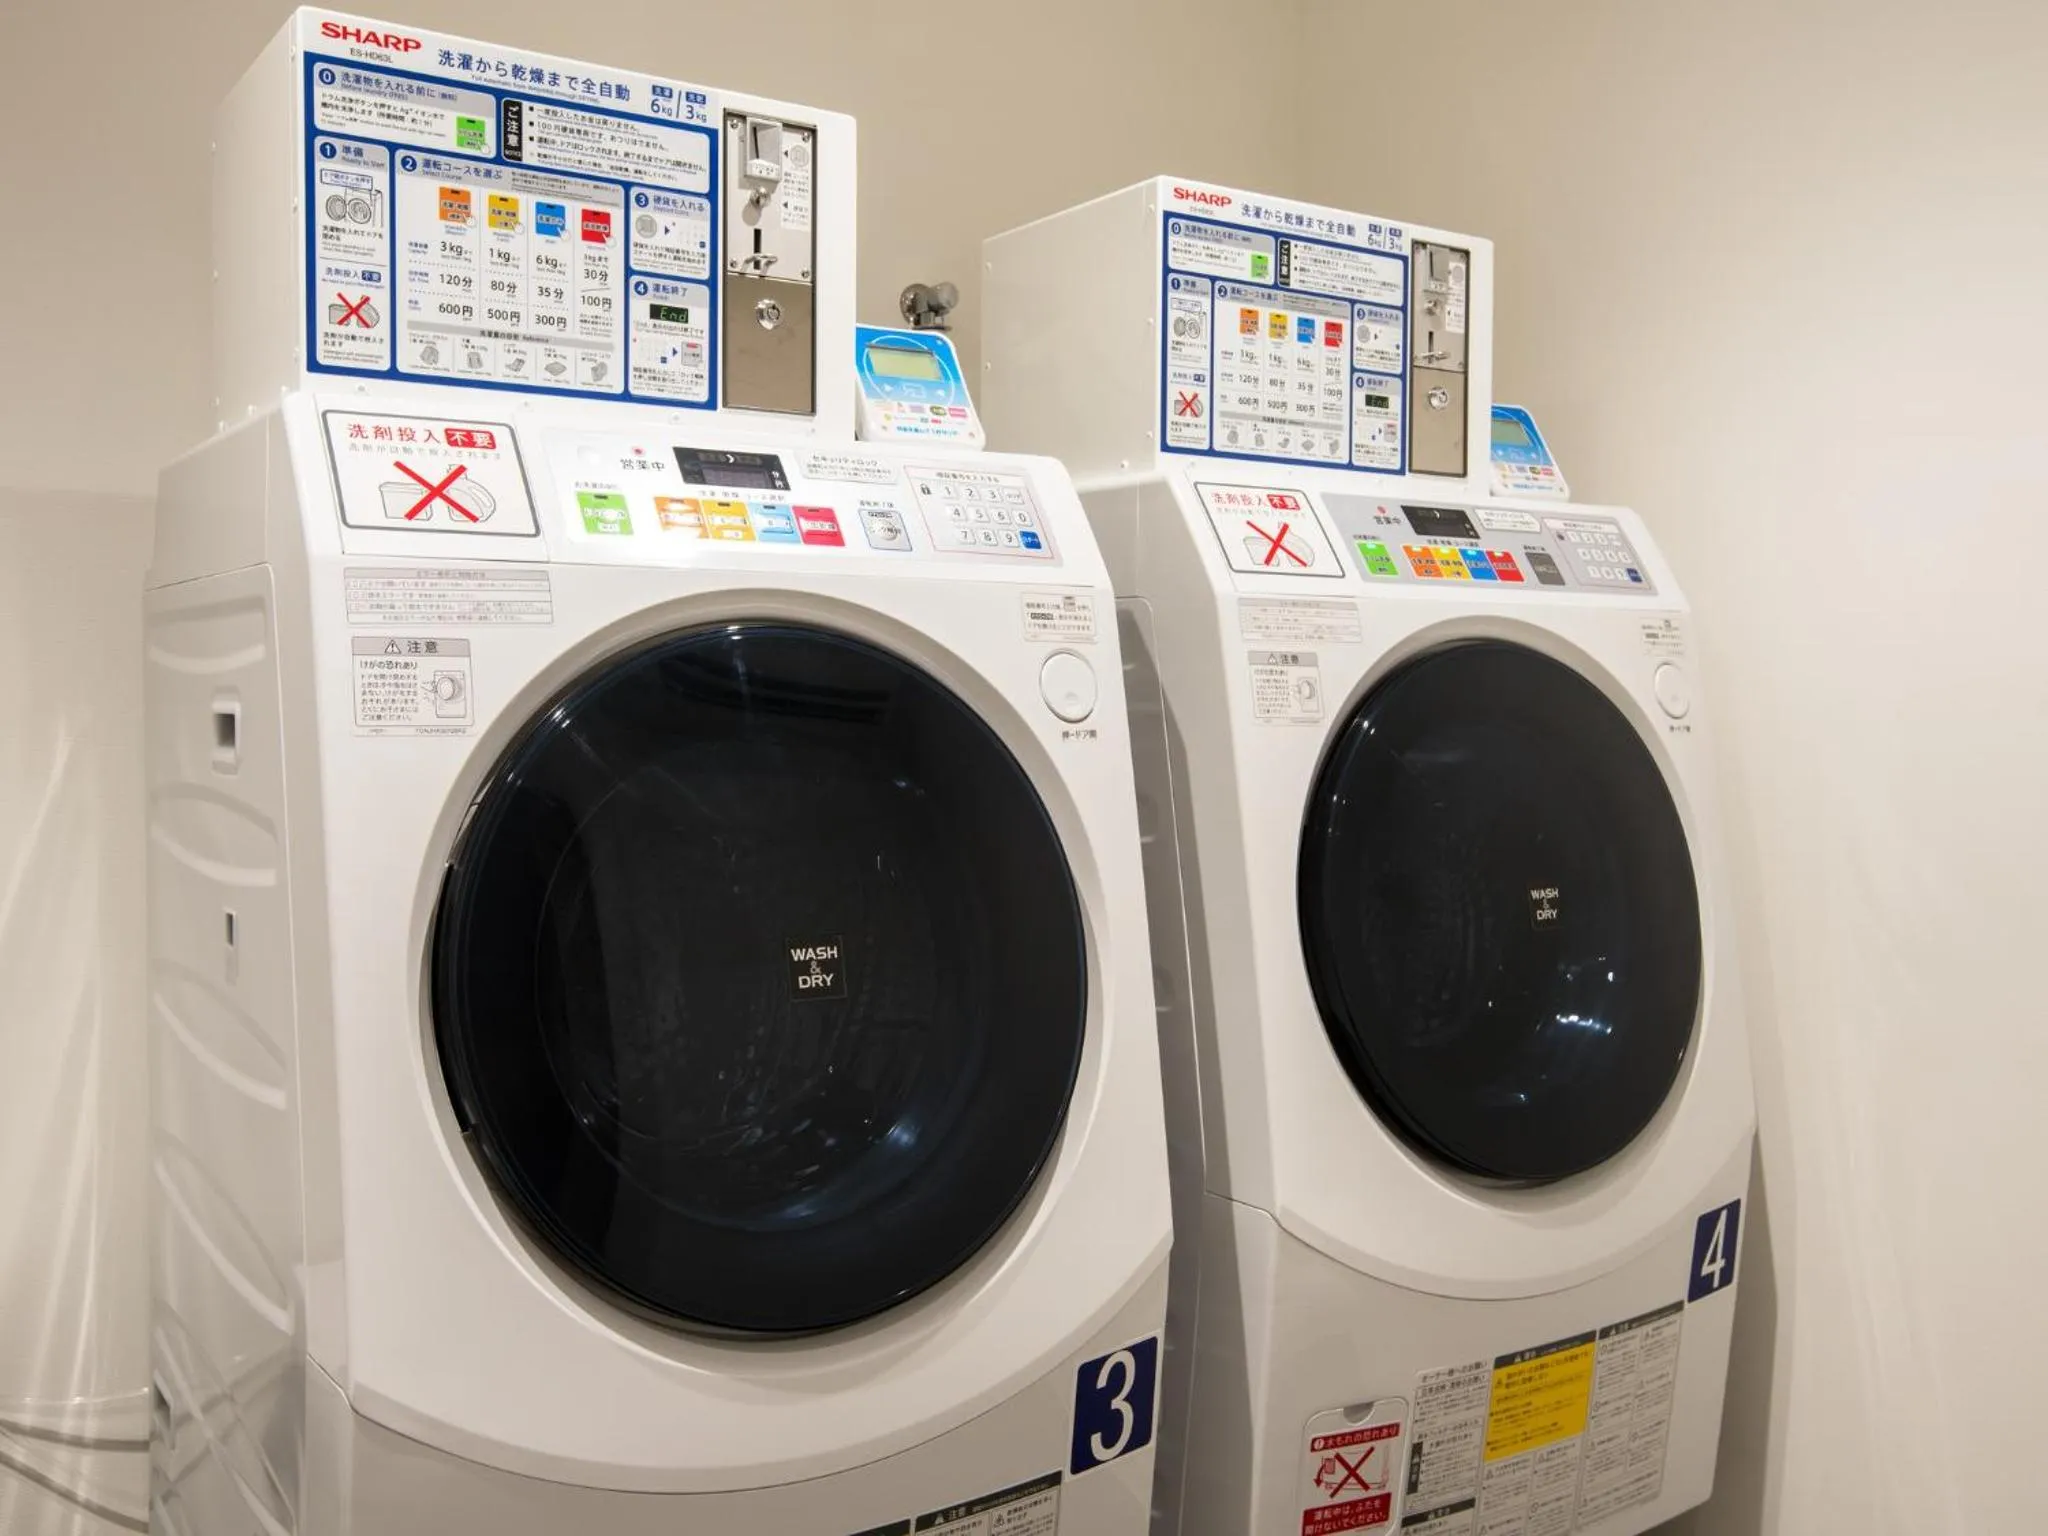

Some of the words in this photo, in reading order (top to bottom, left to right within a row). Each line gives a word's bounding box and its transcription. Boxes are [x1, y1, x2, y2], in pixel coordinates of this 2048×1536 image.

[320, 21, 422, 52] SHARP
[438, 49, 631, 102] 洗濯から乾燥まで全自動
[340, 71, 437, 98] 洗濯物を入れる前に
[422, 158, 503, 180] 運転コースを選ぶ
[653, 194, 705, 212] 硬貨を入れる
[1173, 187, 1233, 208] SHARP
[1241, 204, 1356, 238] 洗濯から乾燥まで全自動
[580, 294, 612, 309] 100円
[438, 303, 473, 318] 600円
[487, 308, 521, 324] 500円
[535, 314, 567, 329] 300円
[347, 423, 441, 445] 洗剤投入
[450, 430, 494, 449] 不要
[619, 458, 666, 472] 営業中
[989, 489, 997, 500] 3
[953, 507, 961, 517] 4
[997, 511, 1005, 521] 6
[1018, 512, 1027, 523] 0
[960, 530, 968, 540] 7
[1005, 533, 1013, 543] 9
[407, 641, 439, 654] 注意
[1530, 886, 1559, 900] WASH
[1536, 908, 1557, 920] DRY
[790, 945, 838, 962] WASH
[810, 960, 822, 974] &
[798, 973, 834, 989] DRY
[1701, 1208, 1728, 1289] 4
[1090, 1349, 1136, 1462] 3
